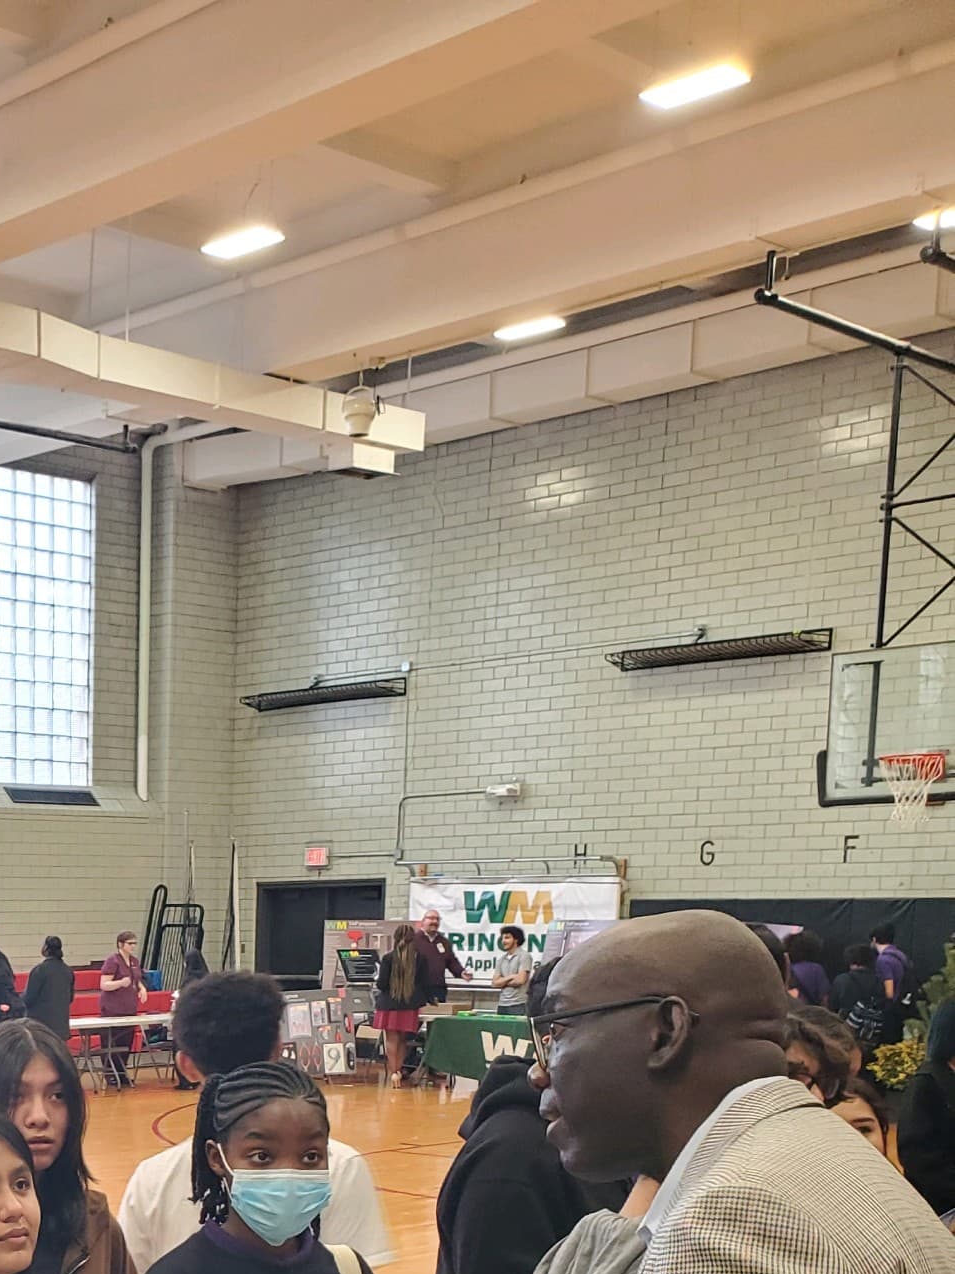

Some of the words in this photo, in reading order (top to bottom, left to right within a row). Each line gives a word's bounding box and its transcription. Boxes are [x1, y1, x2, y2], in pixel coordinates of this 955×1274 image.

[700, 840, 716, 866] G
[842, 835, 860, 863] F
[463, 890, 554, 924] WM
[465, 956, 496, 972] Appl
